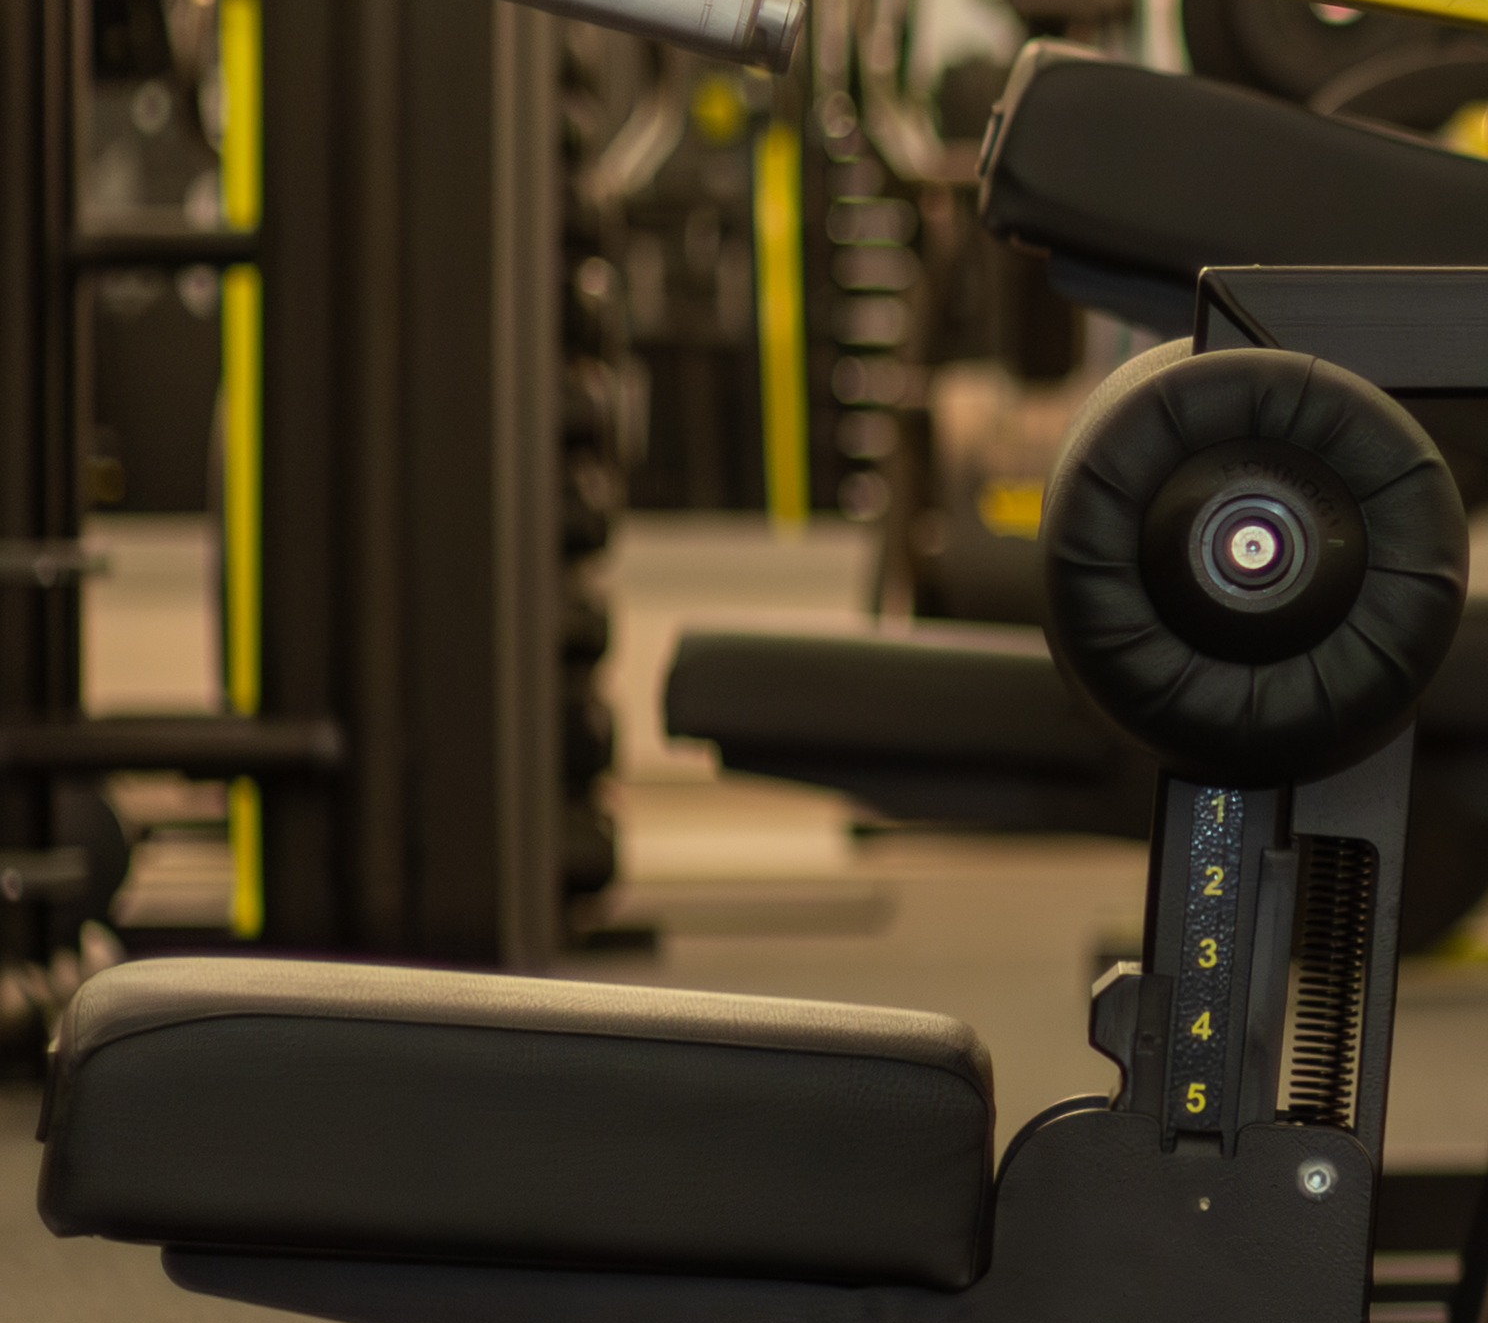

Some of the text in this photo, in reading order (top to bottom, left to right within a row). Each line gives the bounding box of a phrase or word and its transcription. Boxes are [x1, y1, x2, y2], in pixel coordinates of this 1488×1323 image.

[1210, 794, 1226, 824] 1
[1203, 865, 1224, 896] 2
[1198, 937, 1218, 968] 3
[1191, 1011, 1212, 1041] 4
[1185, 1083, 1207, 1113] 5
